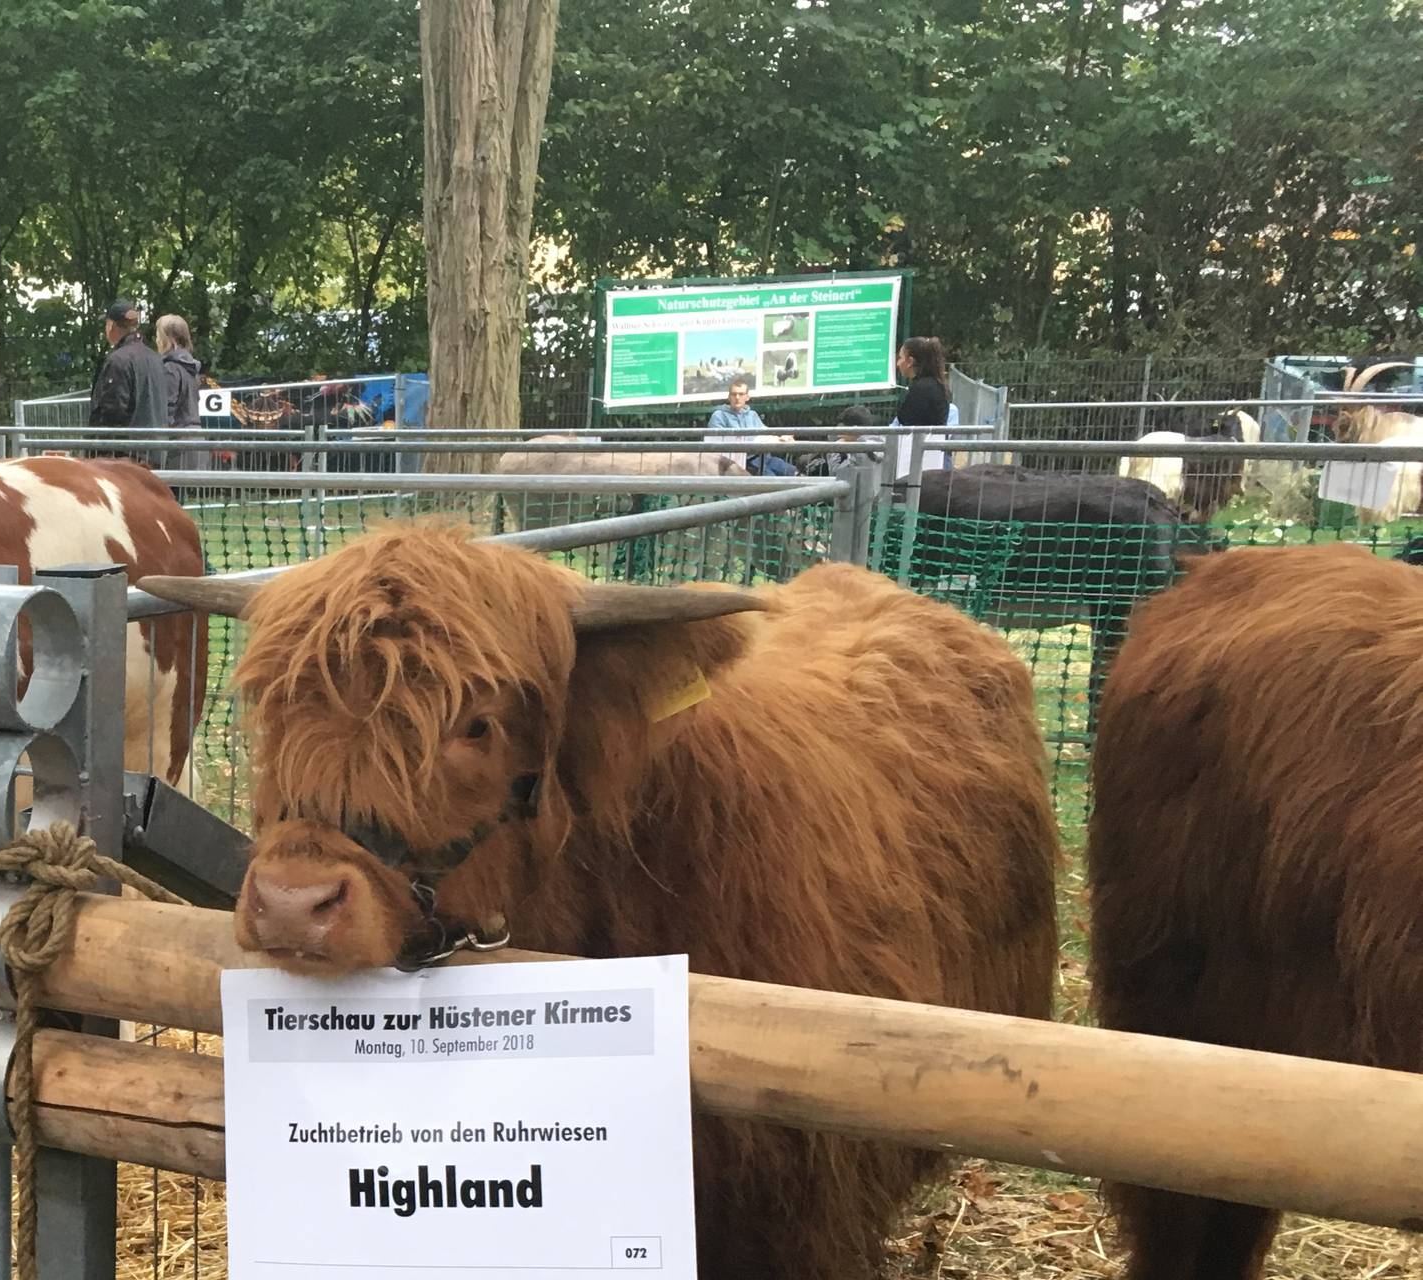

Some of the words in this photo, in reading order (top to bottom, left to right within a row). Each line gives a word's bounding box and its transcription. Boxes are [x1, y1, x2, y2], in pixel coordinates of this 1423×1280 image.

[657, 295, 760, 311] Naturschutzgebiet
[789, 292, 808, 304] der
[205, 393, 222, 412] G
[264, 1006, 375, 1031] Tierschau
[384, 1011, 422, 1031] zur
[429, 1001, 537, 1030] Hüstener
[544, 999, 633, 1026] Kirmes
[354, 1038, 406, 1059] Montag,
[410, 1038, 429, 1055] 10.
[432, 1035, 499, 1058] September
[502, 1033, 535, 1052] 2018
[288, 1122, 404, 1144] Zuchtbetrieb
[411, 1129, 444, 1144] von
[450, 1121, 486, 1143] den
[493, 1120, 608, 1143] Ruhrwiesen
[348, 1163, 543, 1218] Highland
[624, 1247, 648, 1260] 072
